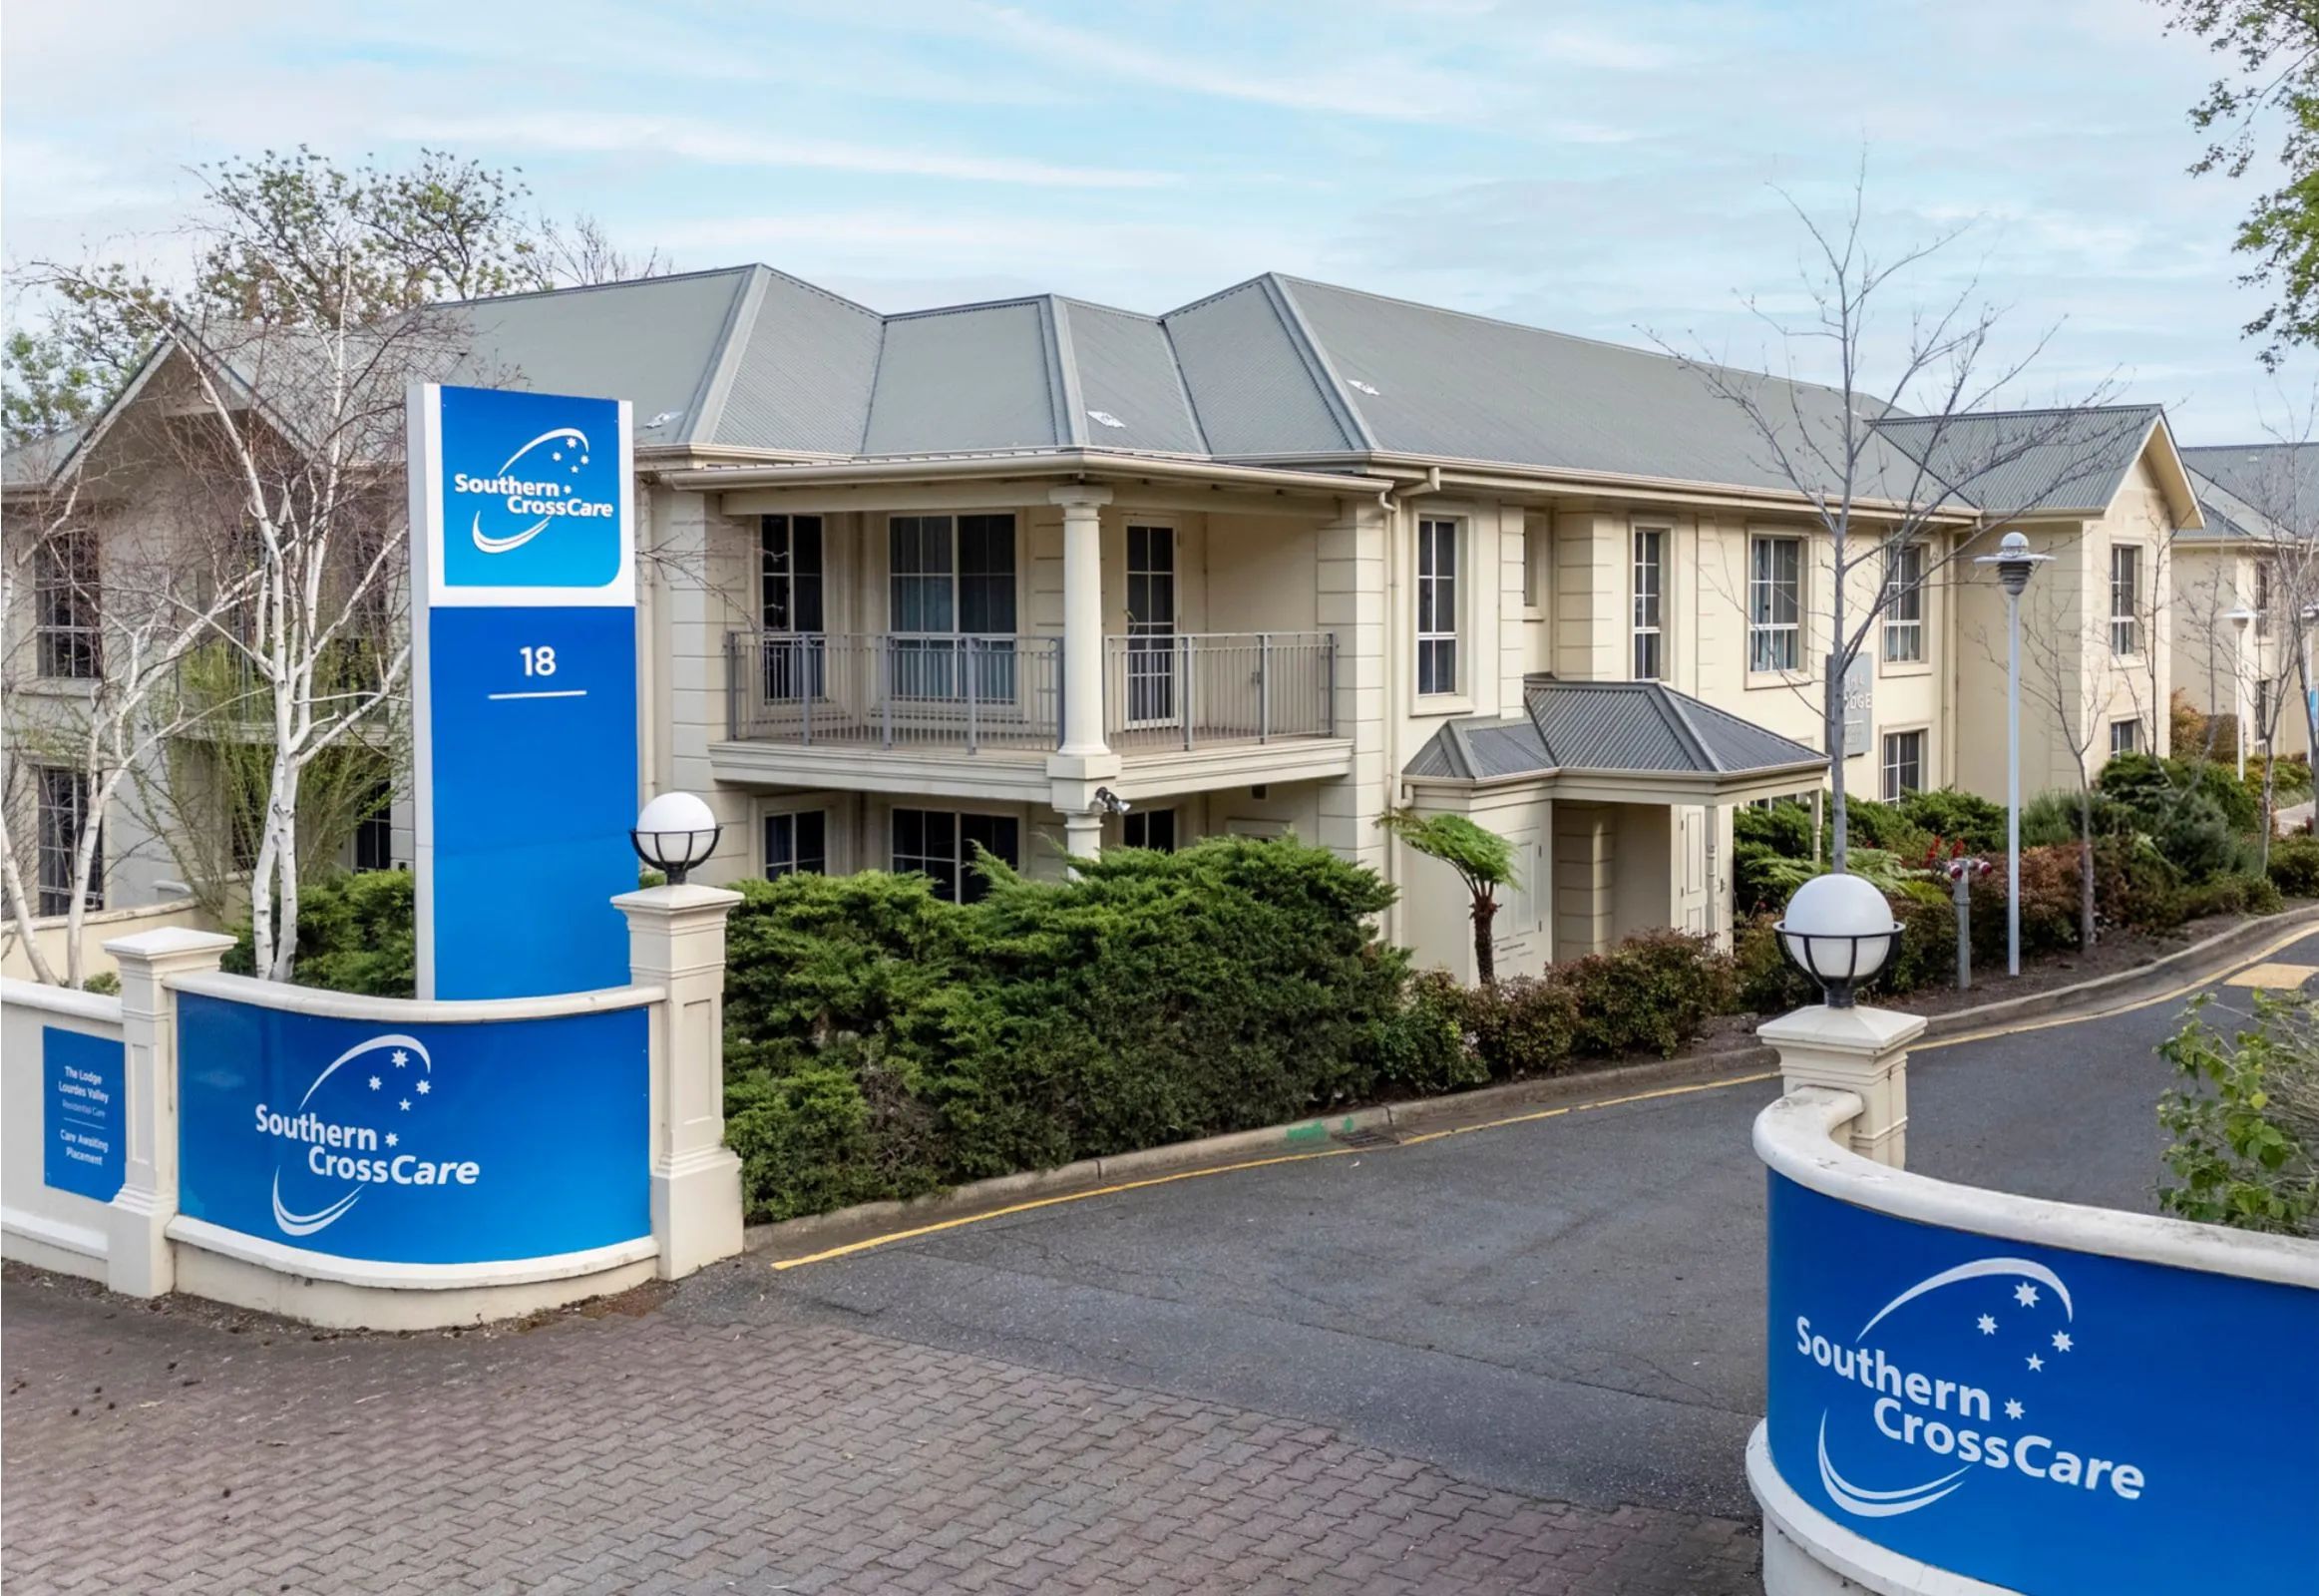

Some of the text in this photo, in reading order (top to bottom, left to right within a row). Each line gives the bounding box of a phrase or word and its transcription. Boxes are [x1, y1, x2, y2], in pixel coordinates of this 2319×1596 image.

[454, 473, 560, 498] Southern
[507, 496, 613, 518] CrossCare
[520, 645, 557, 676] 18
[65, 1065, 102, 1085] The Lodge
[59, 1080, 109, 1104] Lourdes Valley
[255, 1103, 378, 1151] Southern
[60, 1129, 109, 1153] Care Awaiting
[66, 1147, 103, 1166] Placement
[308, 1145, 480, 1185] CrossCare
[1796, 1316, 1991, 1422] Southern
[1873, 1397, 2145, 1500] CrossCare
